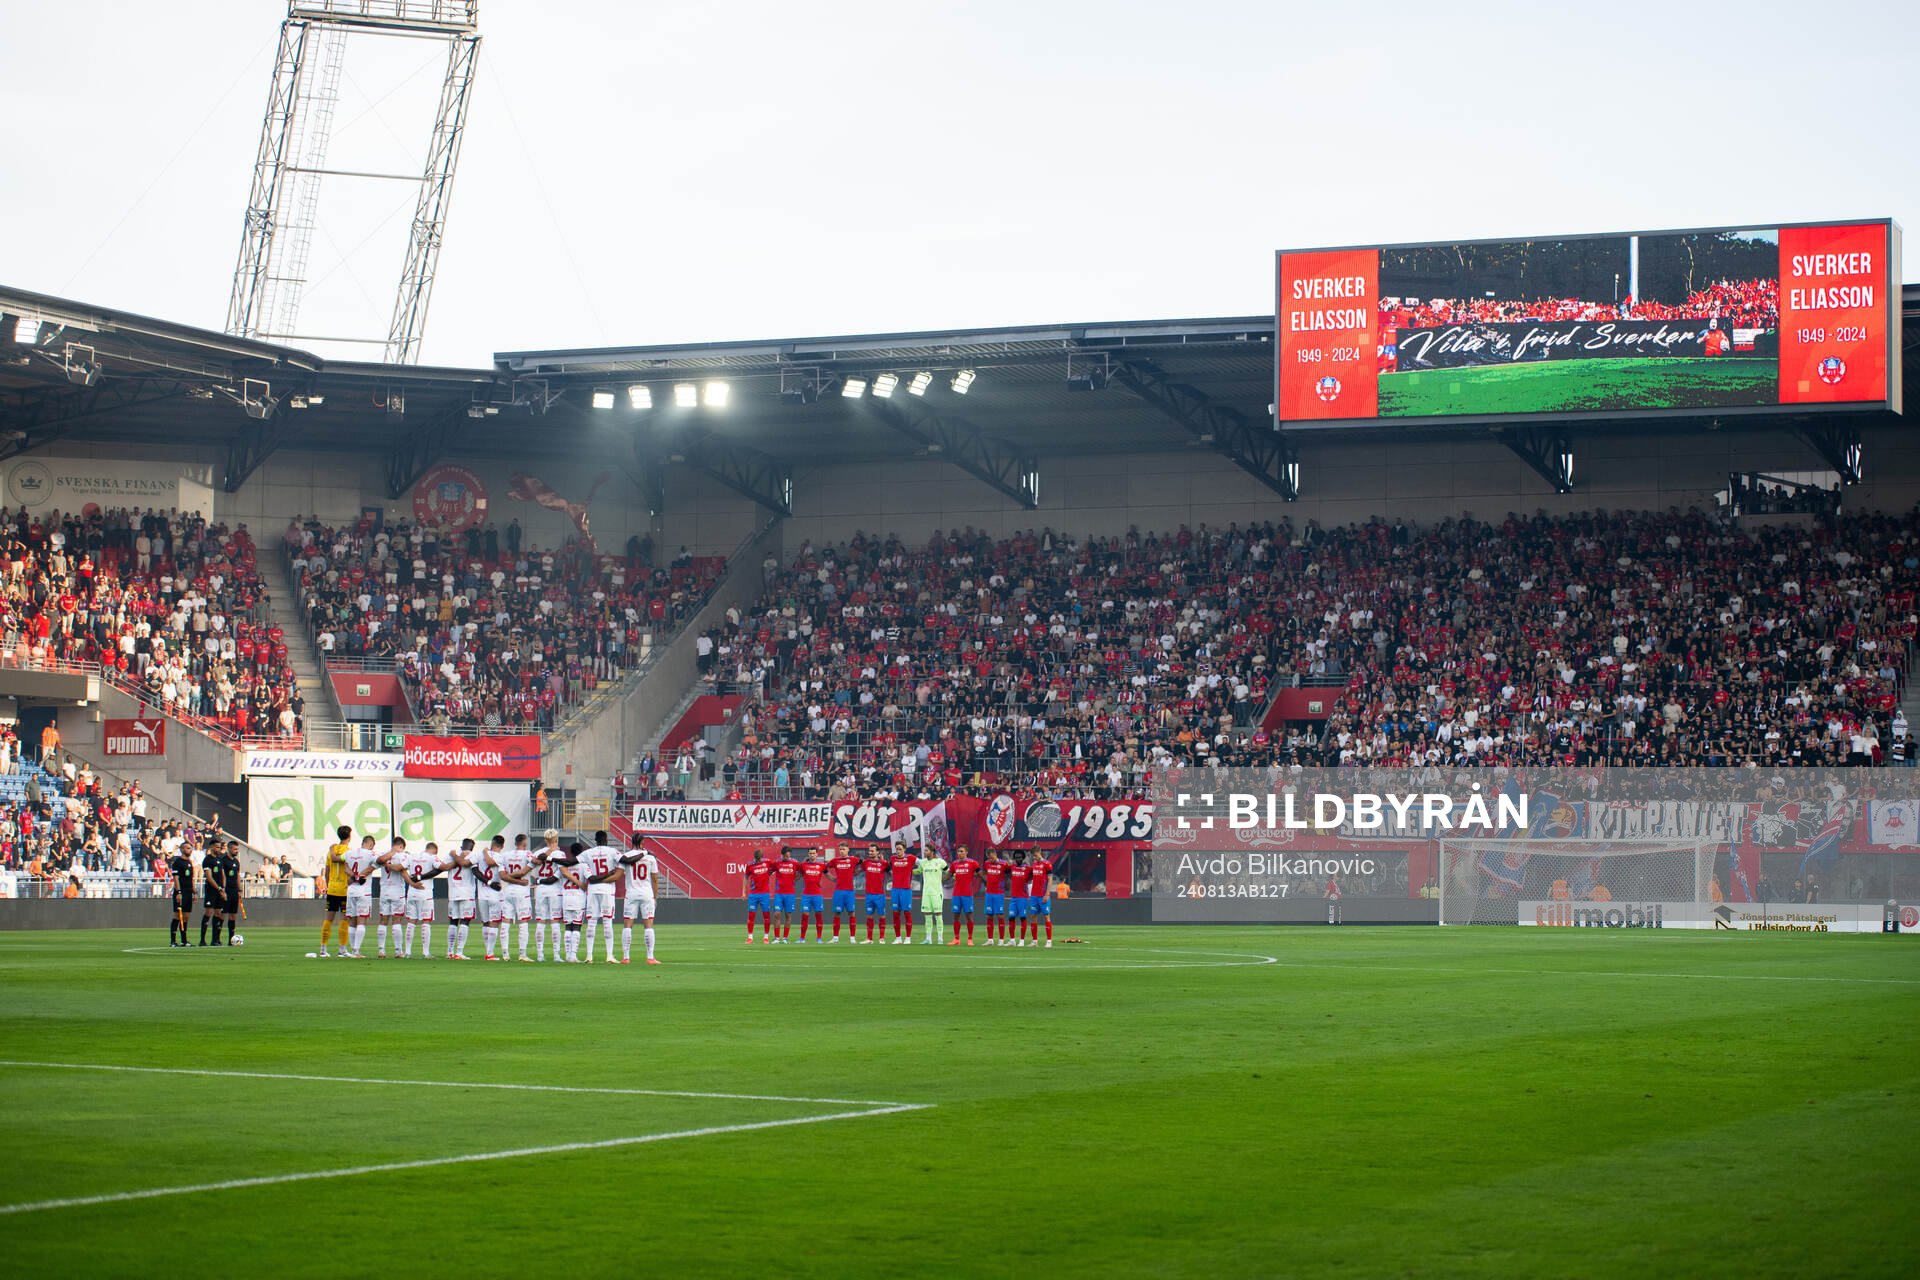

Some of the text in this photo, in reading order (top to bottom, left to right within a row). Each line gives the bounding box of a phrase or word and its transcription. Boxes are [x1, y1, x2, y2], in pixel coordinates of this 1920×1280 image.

[1792, 252, 1872, 276] SVERKER
[1293, 277, 1365, 299] SVERKER
[1790, 286, 1874, 310] ELIASSON
[1291, 308, 1367, 331] ELIASSON
[1400, 323, 1696, 361] Vila i frid Sverker
[1797, 328, 1825, 343] 1949
[1836, 326, 1867, 342] 2024
[1297, 348, 1322, 363] 1949
[1332, 347, 1360, 362] 2024
[56, 476, 176, 490] SVENSKA FINANS
[107, 736, 149, 754] PUMA
[250, 756, 340, 771] KLIPPANS
[344, 758, 391, 772] BUSS
[405, 746, 502, 767] HÖGERSVÄNGEN
[267, 784, 434, 841] akea
[637, 805, 829, 824] AVSTÄNGDA HIF:ARE
[1065, 804, 1156, 839] 1985
[1235, 823, 1296, 844] Carlsberg
[414, 864, 423, 876] 8
[452, 864, 463, 880] 2
[538, 861, 554, 878] 23
[593, 858, 609, 875] 15
[630, 863, 648, 881] 10
[1536, 903, 1663, 929] tillmobil
[1739, 912, 1837, 924] Jönssons Plåtslageri
[1814, 925, 1829, 933] AB
